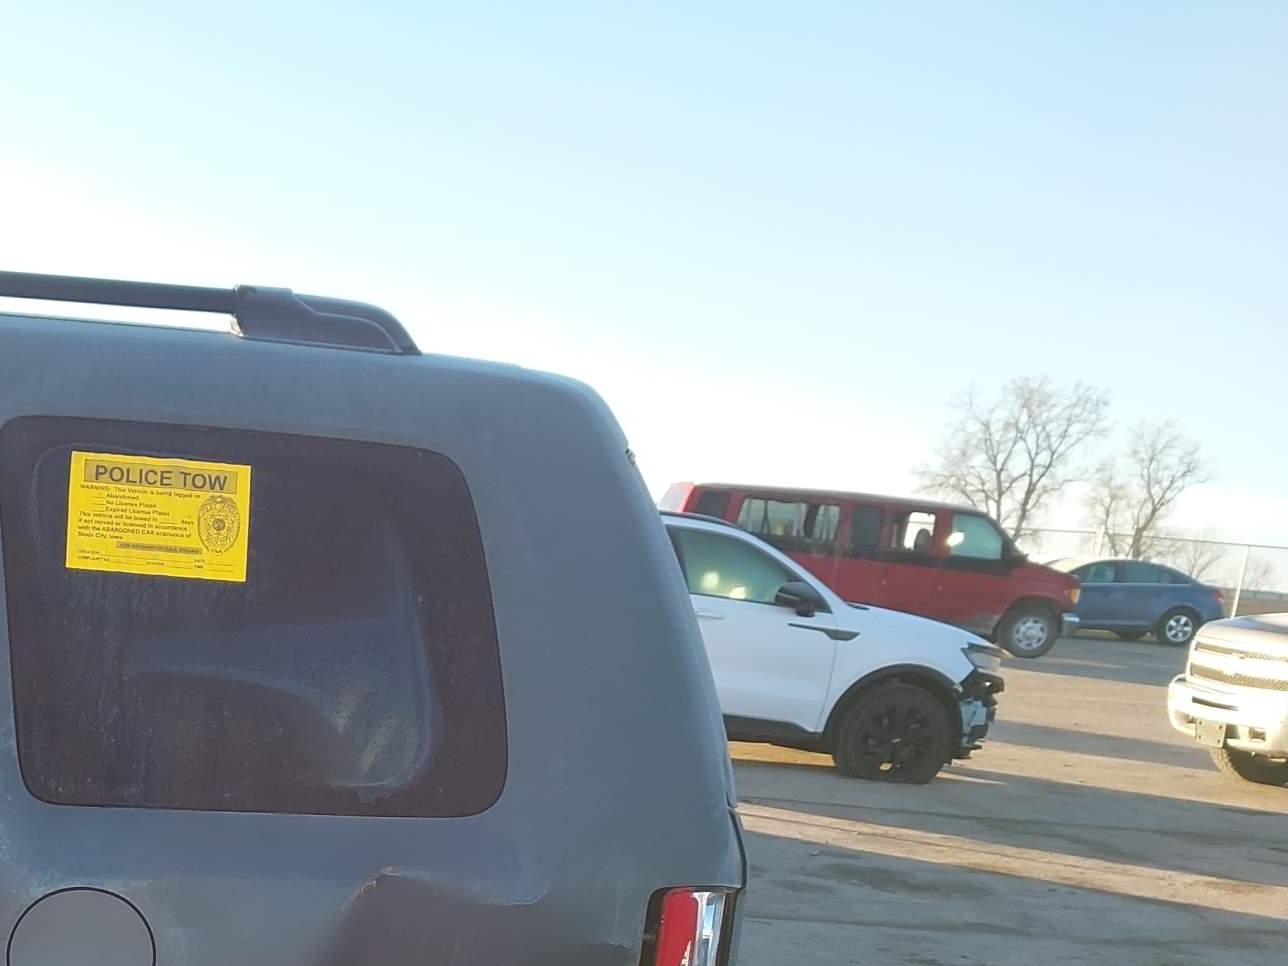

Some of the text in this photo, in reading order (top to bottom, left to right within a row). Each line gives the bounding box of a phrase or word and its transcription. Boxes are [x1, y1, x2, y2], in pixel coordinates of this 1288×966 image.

[95, 465, 228, 491] POLICE TOW
[80, 484, 110, 492] WARNING:
[102, 526, 140, 534] ABANDONED
[155, 530, 184, 538] ordinance
